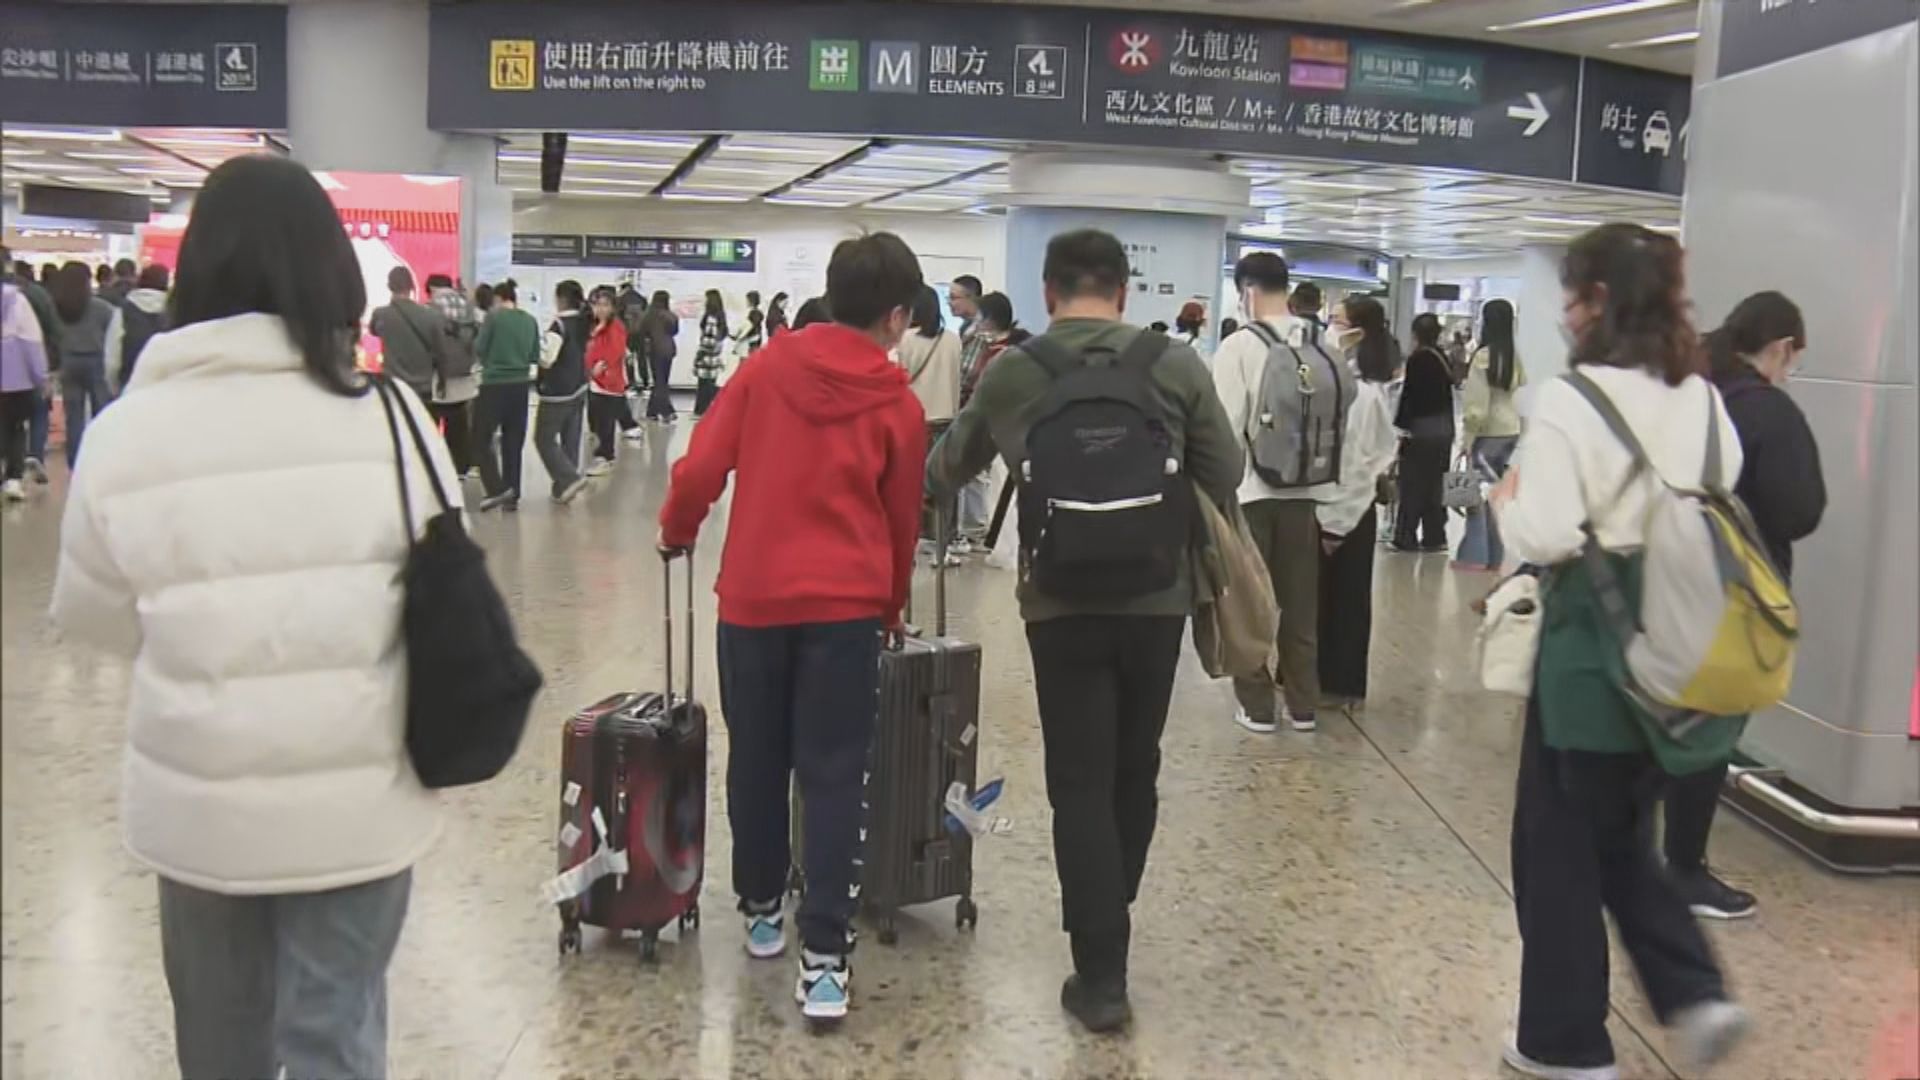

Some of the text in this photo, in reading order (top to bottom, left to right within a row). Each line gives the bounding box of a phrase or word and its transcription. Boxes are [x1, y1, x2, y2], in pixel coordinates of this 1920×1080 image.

[544, 41, 789, 71] 使用右面升降機前往
[1172, 27, 1258, 63] 九龍站
[877, 49, 912, 85] M
[930, 45, 988, 76] 圓方
[1169, 61, 1231, 78] Kowloon
[1232, 65, 1281, 83] Station
[543, 74, 706, 93] Use the lift on the right to
[928, 79, 1004, 95] ELEMENTS
[1025, 79, 1036, 94] 8
[1105, 90, 1214, 116] 西九文化區
[1243, 99, 1277, 120] M+
[1304, 102, 1474, 138] 香港故宮文化博物館
[1600, 103, 1637, 132] 的士
